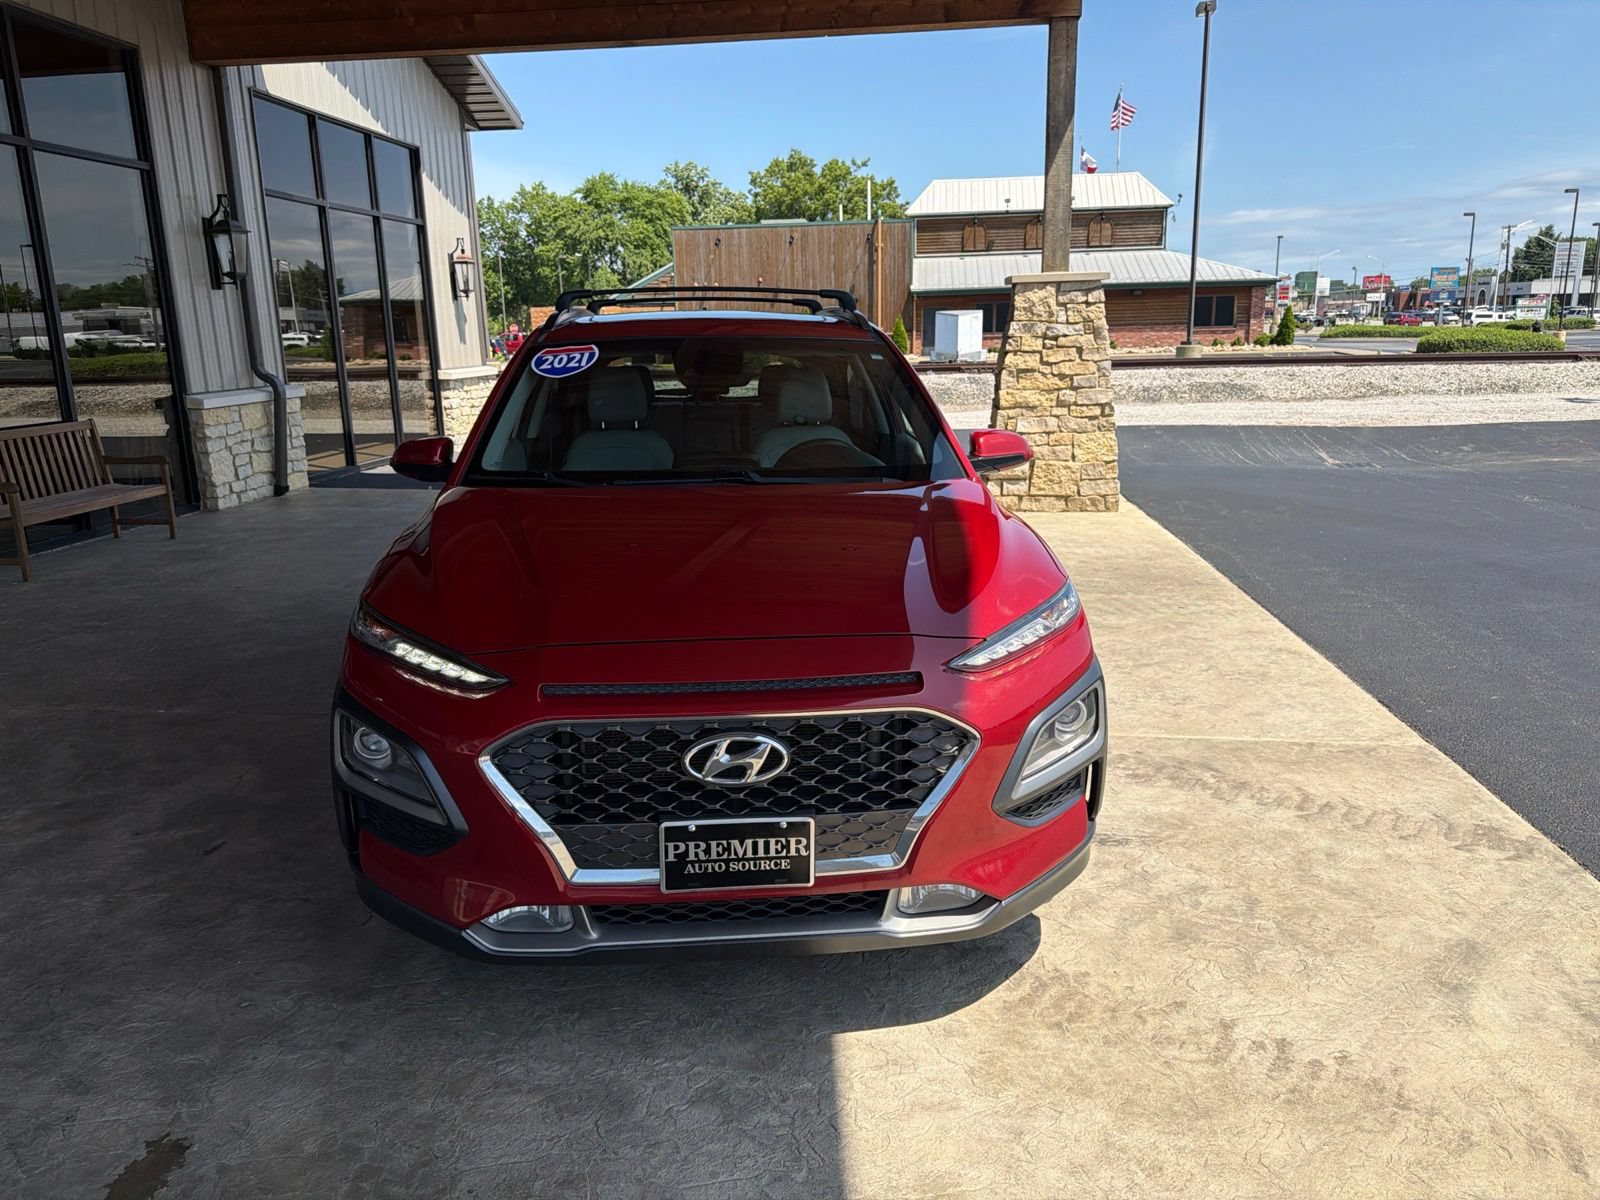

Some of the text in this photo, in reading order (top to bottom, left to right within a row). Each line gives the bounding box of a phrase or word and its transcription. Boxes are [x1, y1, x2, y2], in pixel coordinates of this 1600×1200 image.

[538, 352, 590, 369] 2021
[665, 837, 810, 862] PREMIER
[684, 859, 791, 874] AUTO SOURCE
